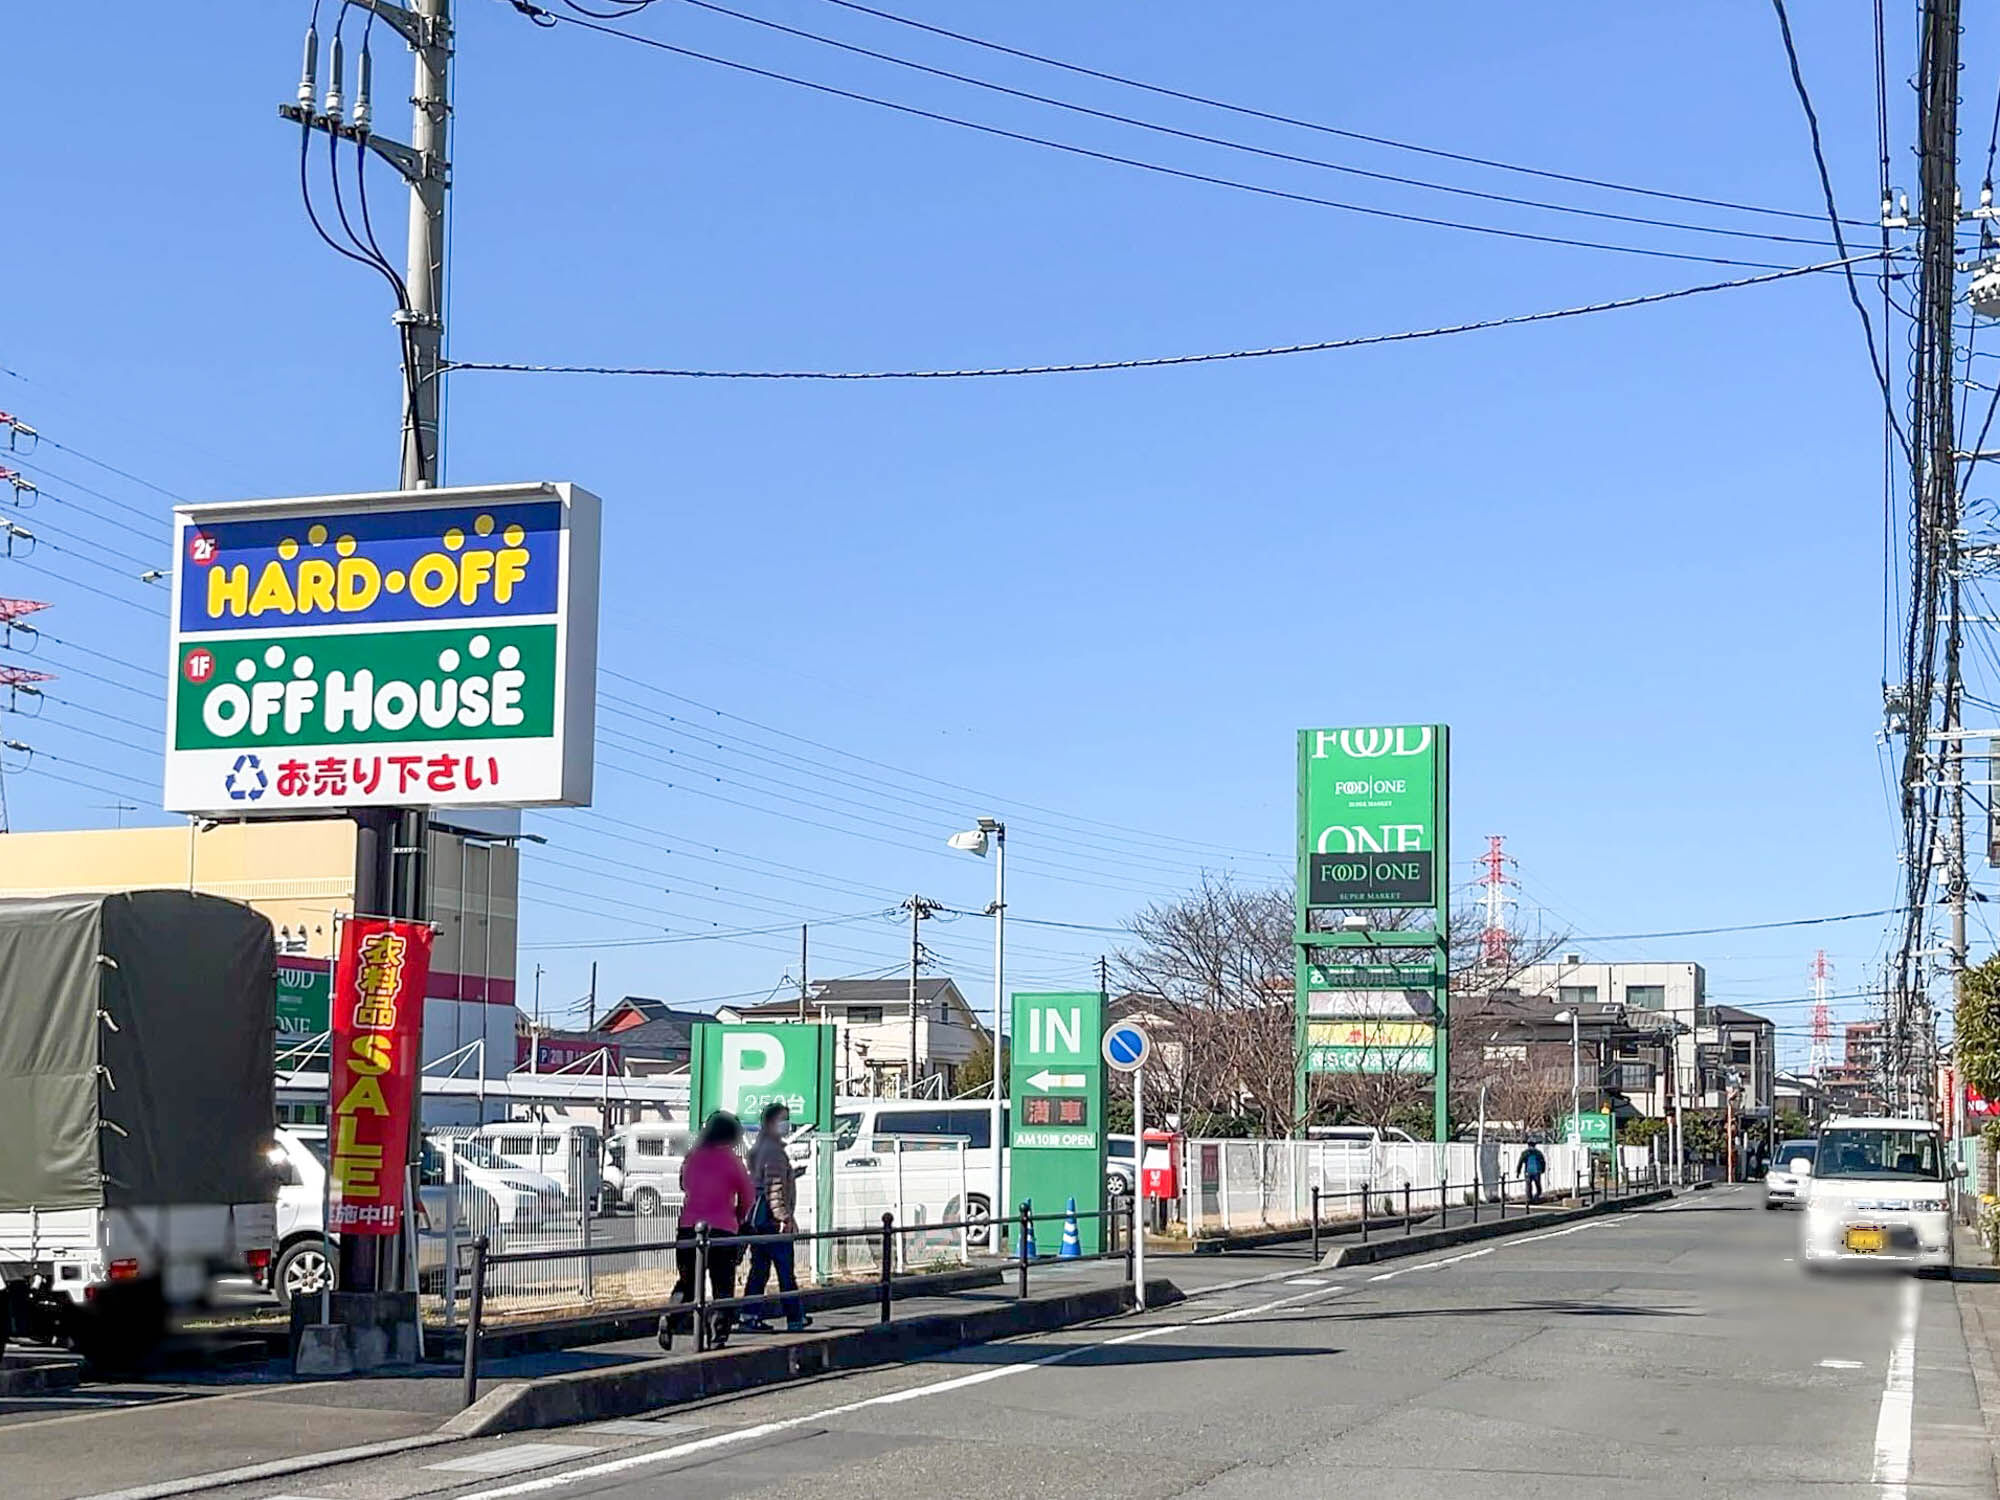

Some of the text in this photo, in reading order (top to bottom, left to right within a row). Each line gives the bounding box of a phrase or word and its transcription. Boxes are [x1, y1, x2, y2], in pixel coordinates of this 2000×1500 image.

[193, 538, 216, 560] 2F
[189, 657, 210, 678] 1F
[202, 668, 526, 738] OFF HOUSE
[1312, 726, 1432, 759] FOOD
[276, 753, 499, 797] お売り下さい
[1335, 780, 1407, 795] FOOD ONE
[1317, 824, 1424, 853] ONE
[1321, 863, 1421, 882] FOOD ONE
[277, 969, 315, 989] OOD
[357, 934, 405, 1027] 衣料品
[1029, 1008, 1082, 1054] IN
[721, 1032, 785, 1112] P
[333, 1035, 393, 1197] SALE
[1062, 1133, 1094, 1146] OPEN
